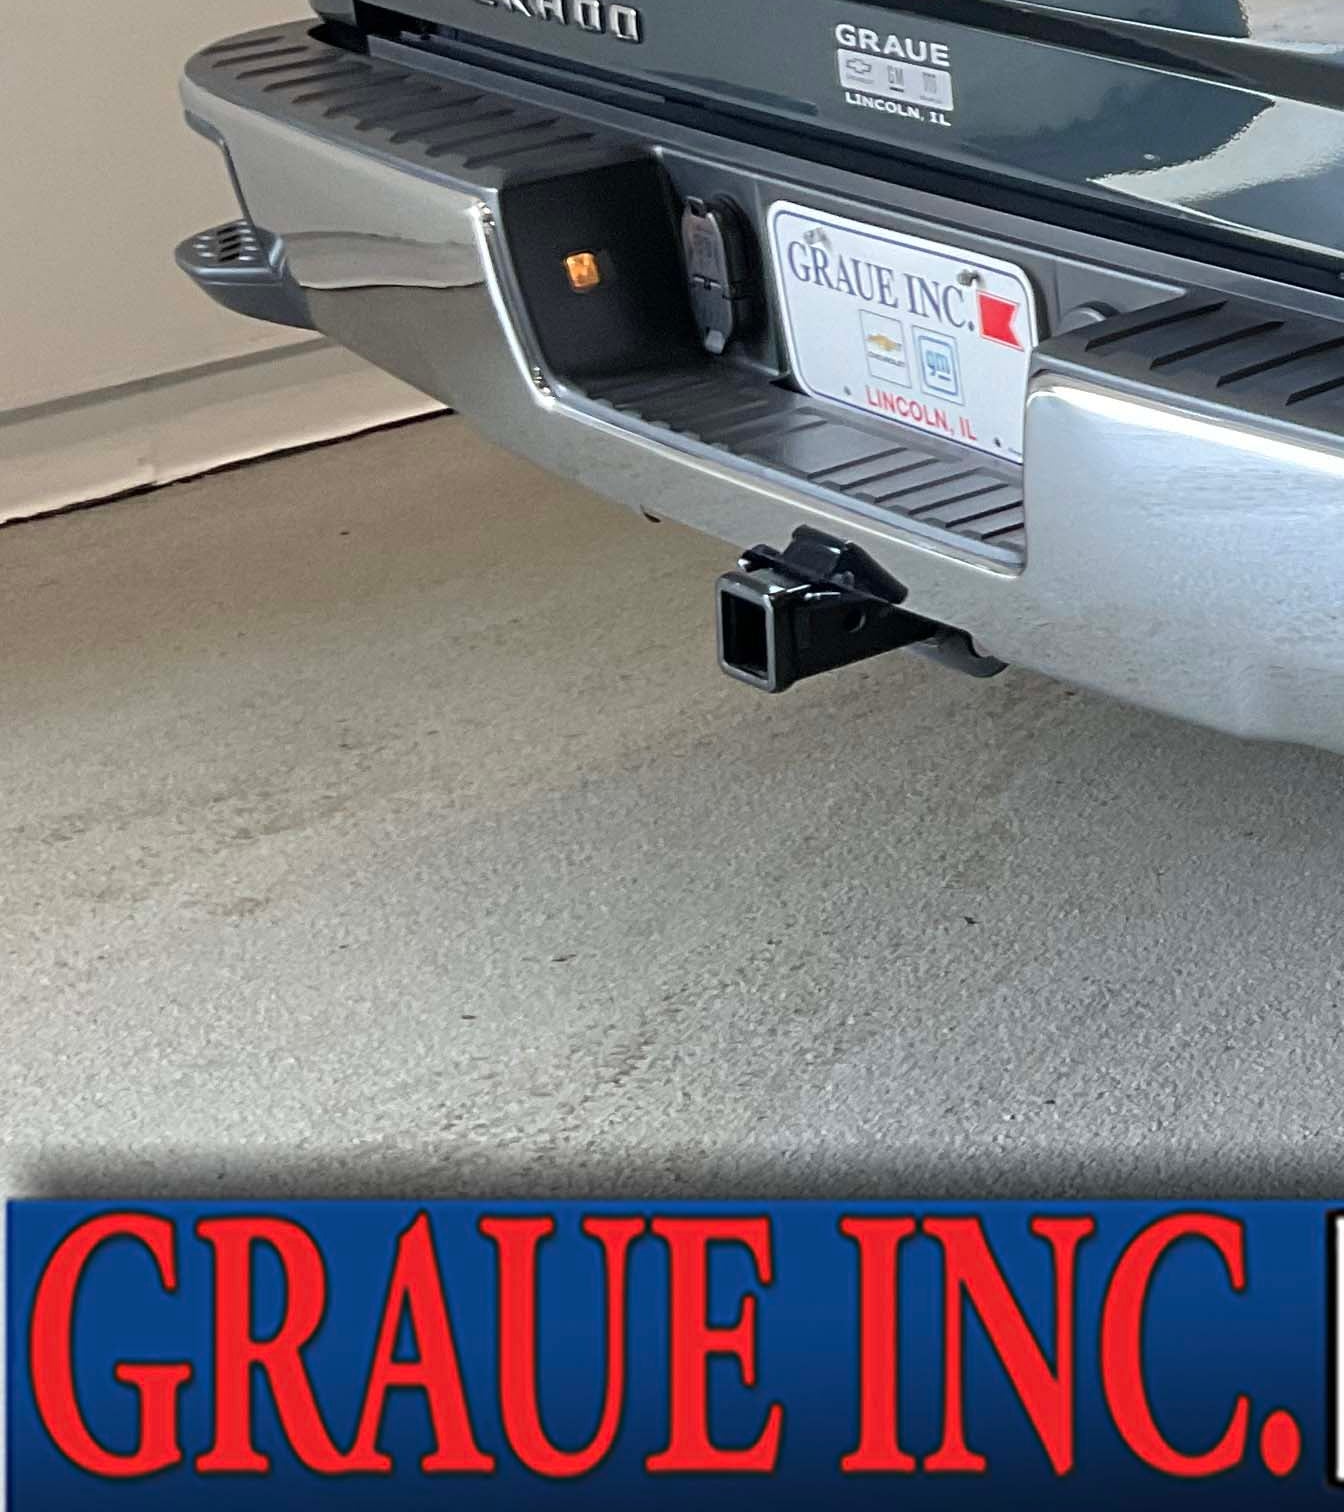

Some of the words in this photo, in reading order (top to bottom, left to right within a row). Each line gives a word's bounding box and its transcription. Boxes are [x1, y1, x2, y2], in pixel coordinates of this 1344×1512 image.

[835, 23, 950, 67] GRAUE
[928, 111, 952, 127] IL
[787, 240, 899, 309] GRAUE
[903, 273, 976, 332] INC.
[959, 416, 977, 441] IL
